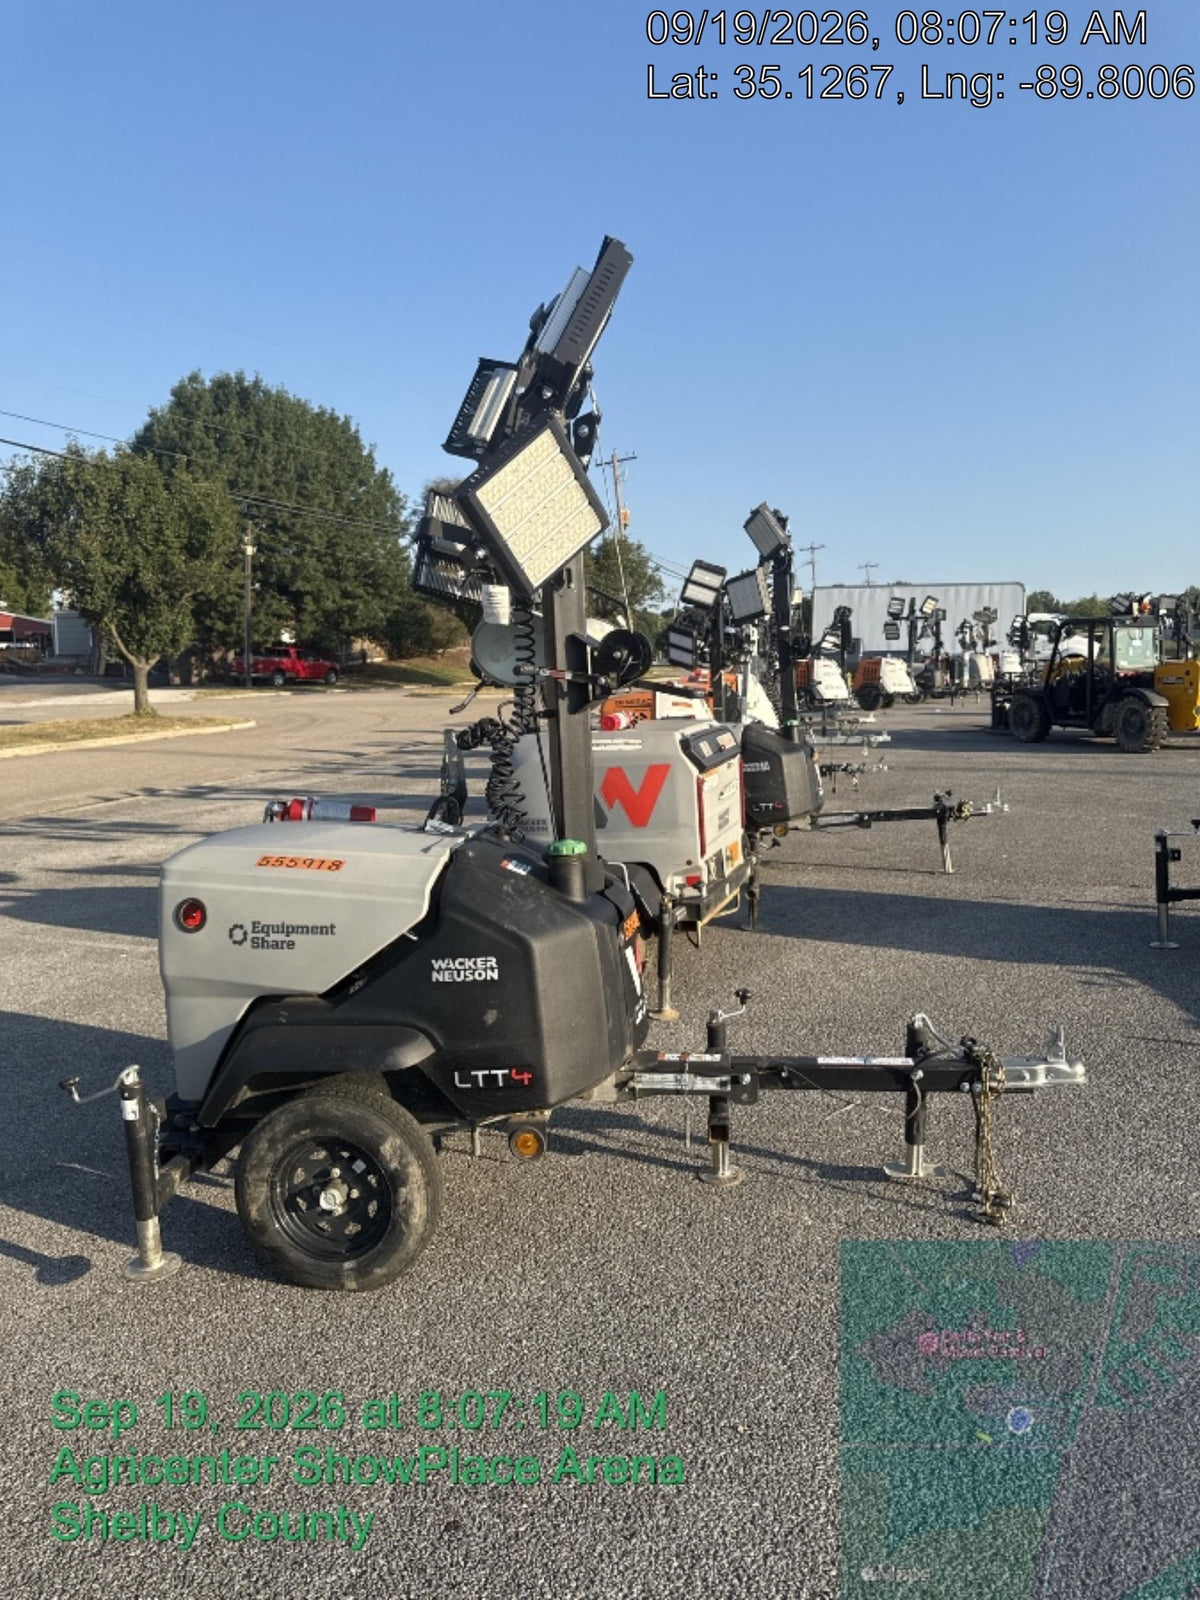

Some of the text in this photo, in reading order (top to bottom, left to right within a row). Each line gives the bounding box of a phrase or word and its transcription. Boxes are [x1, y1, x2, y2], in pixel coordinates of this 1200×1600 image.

[257, 856, 343, 872] 555918
[251, 921, 336, 938] Equipment
[251, 937, 296, 950] Share
[431, 956, 499, 970] WACKER
[431, 969, 499, 982] NEUSON
[454, 1068, 532, 1088] LTT4
